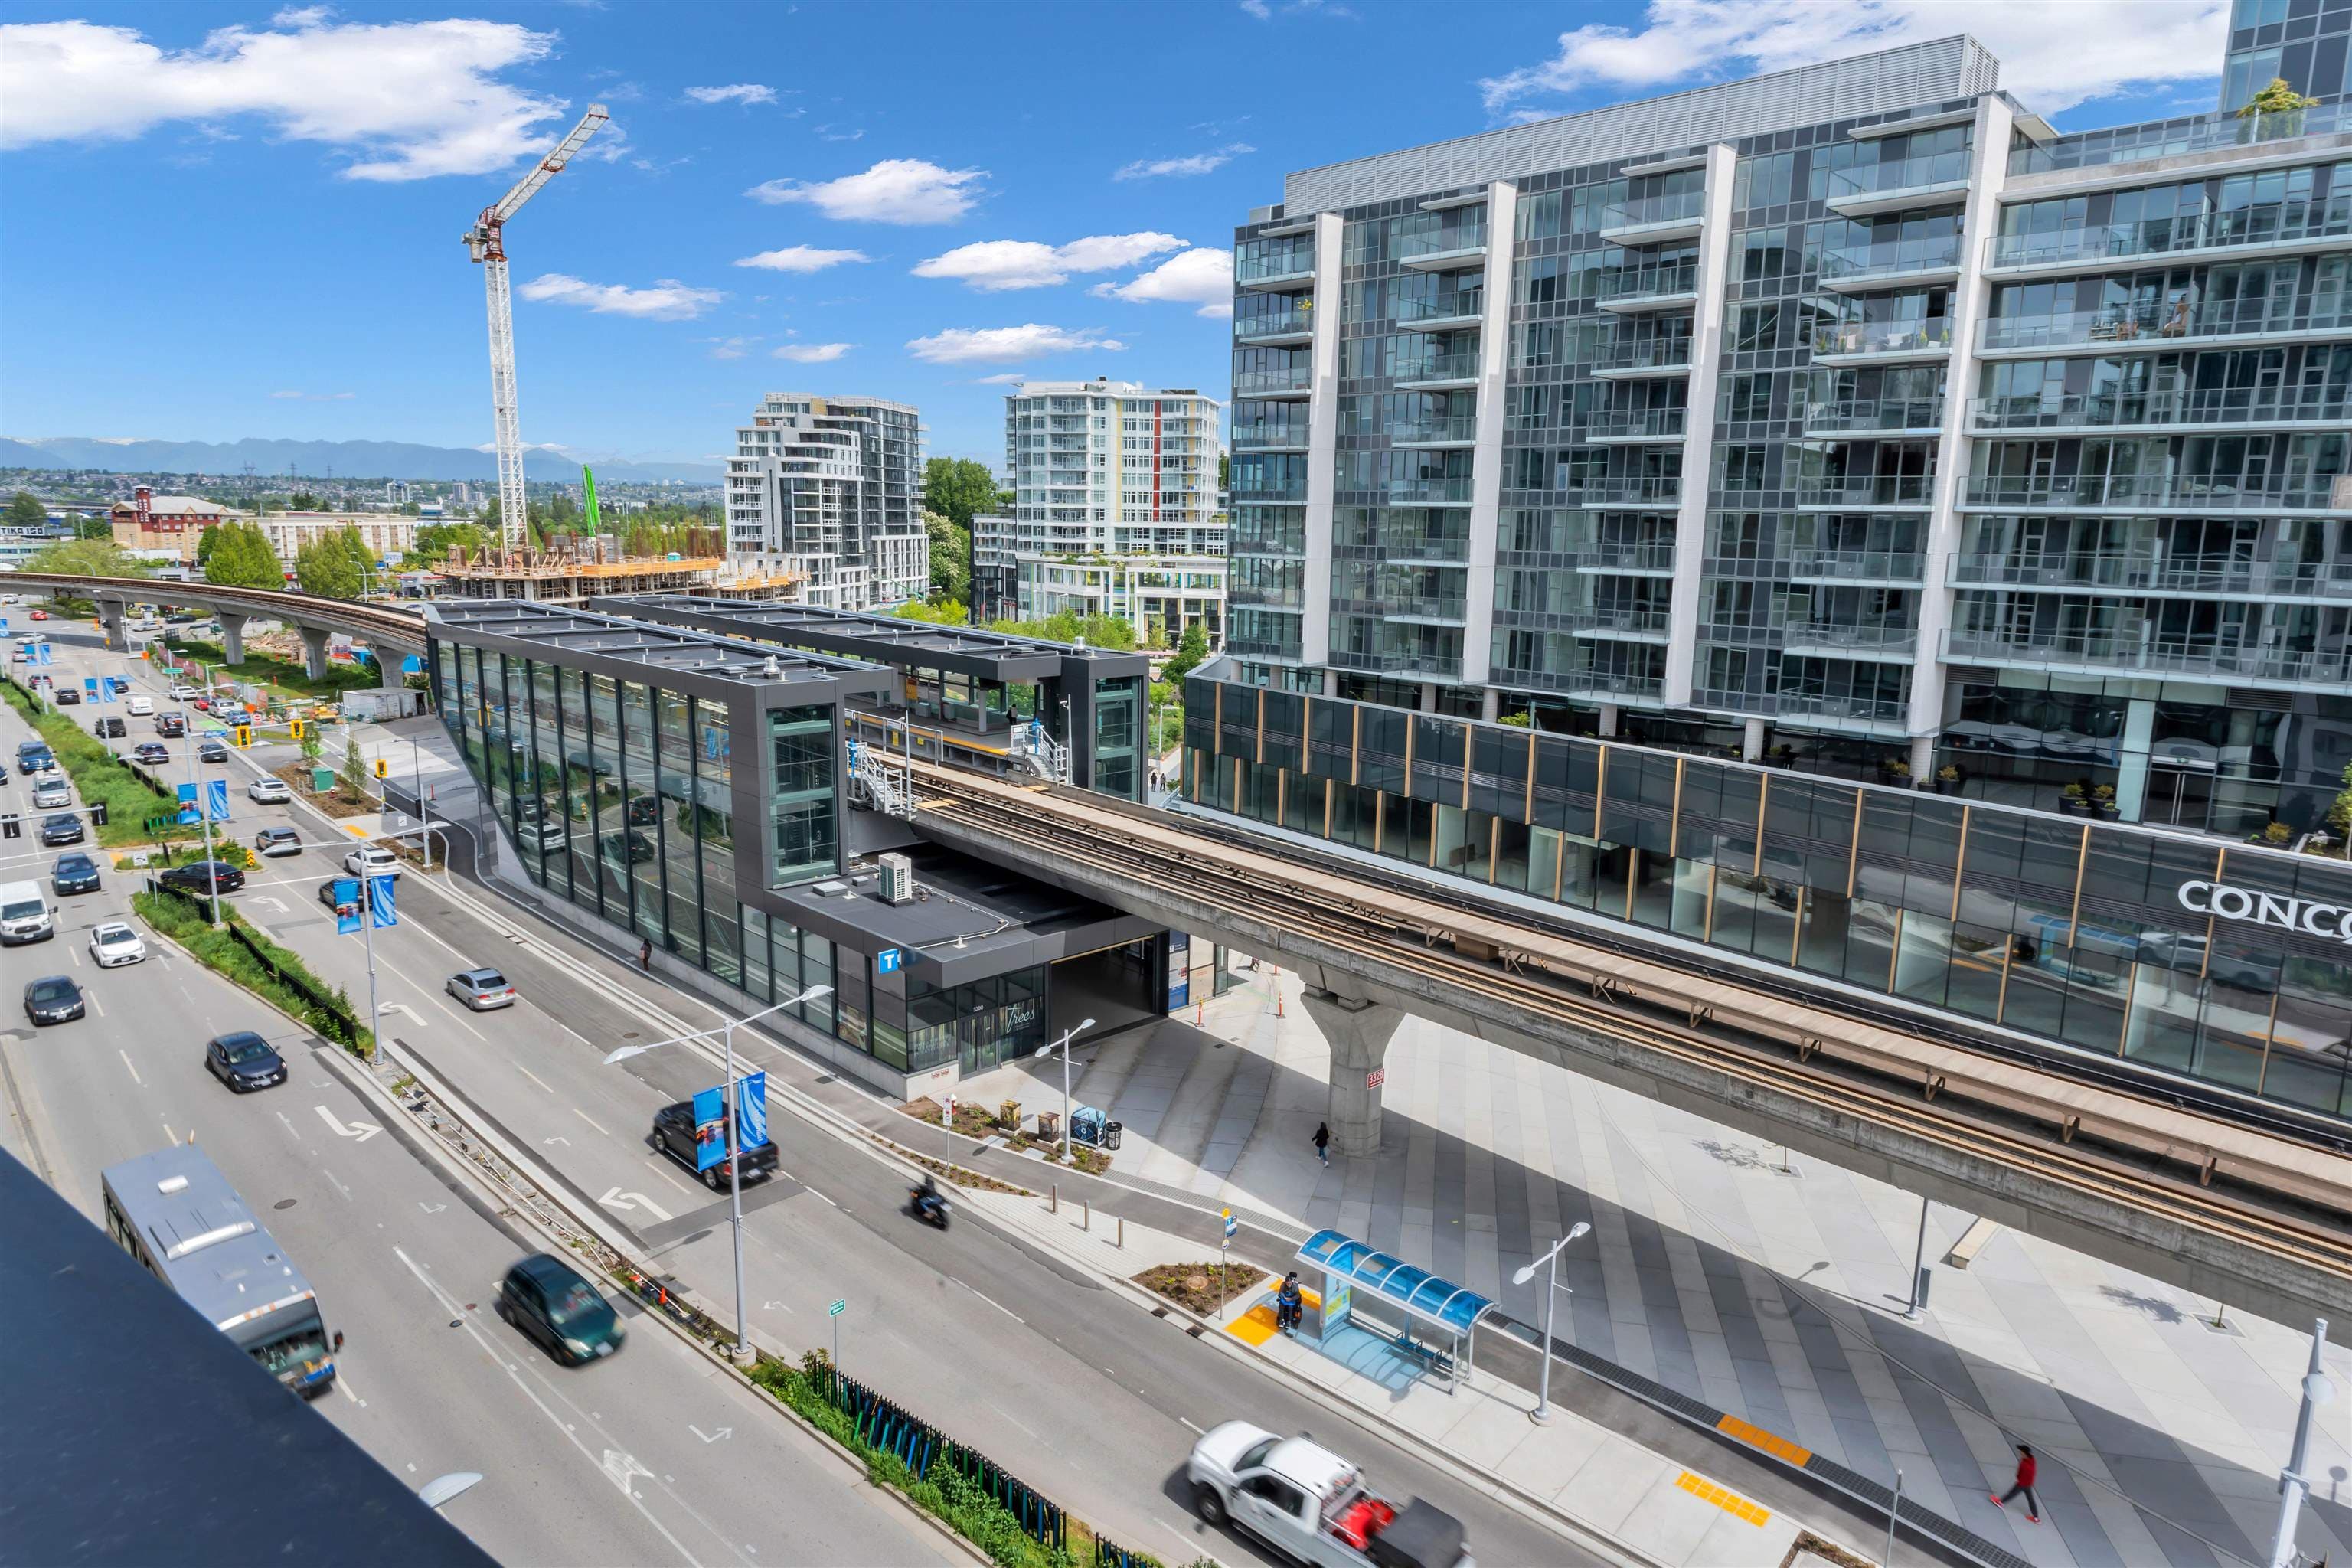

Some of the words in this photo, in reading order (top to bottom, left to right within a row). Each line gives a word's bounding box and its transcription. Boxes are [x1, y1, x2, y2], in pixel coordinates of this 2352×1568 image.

[884, 953, 895, 969] T
[1007, 1007, 1035, 1033] Trees
[1369, 1070, 1383, 1084] 3328
